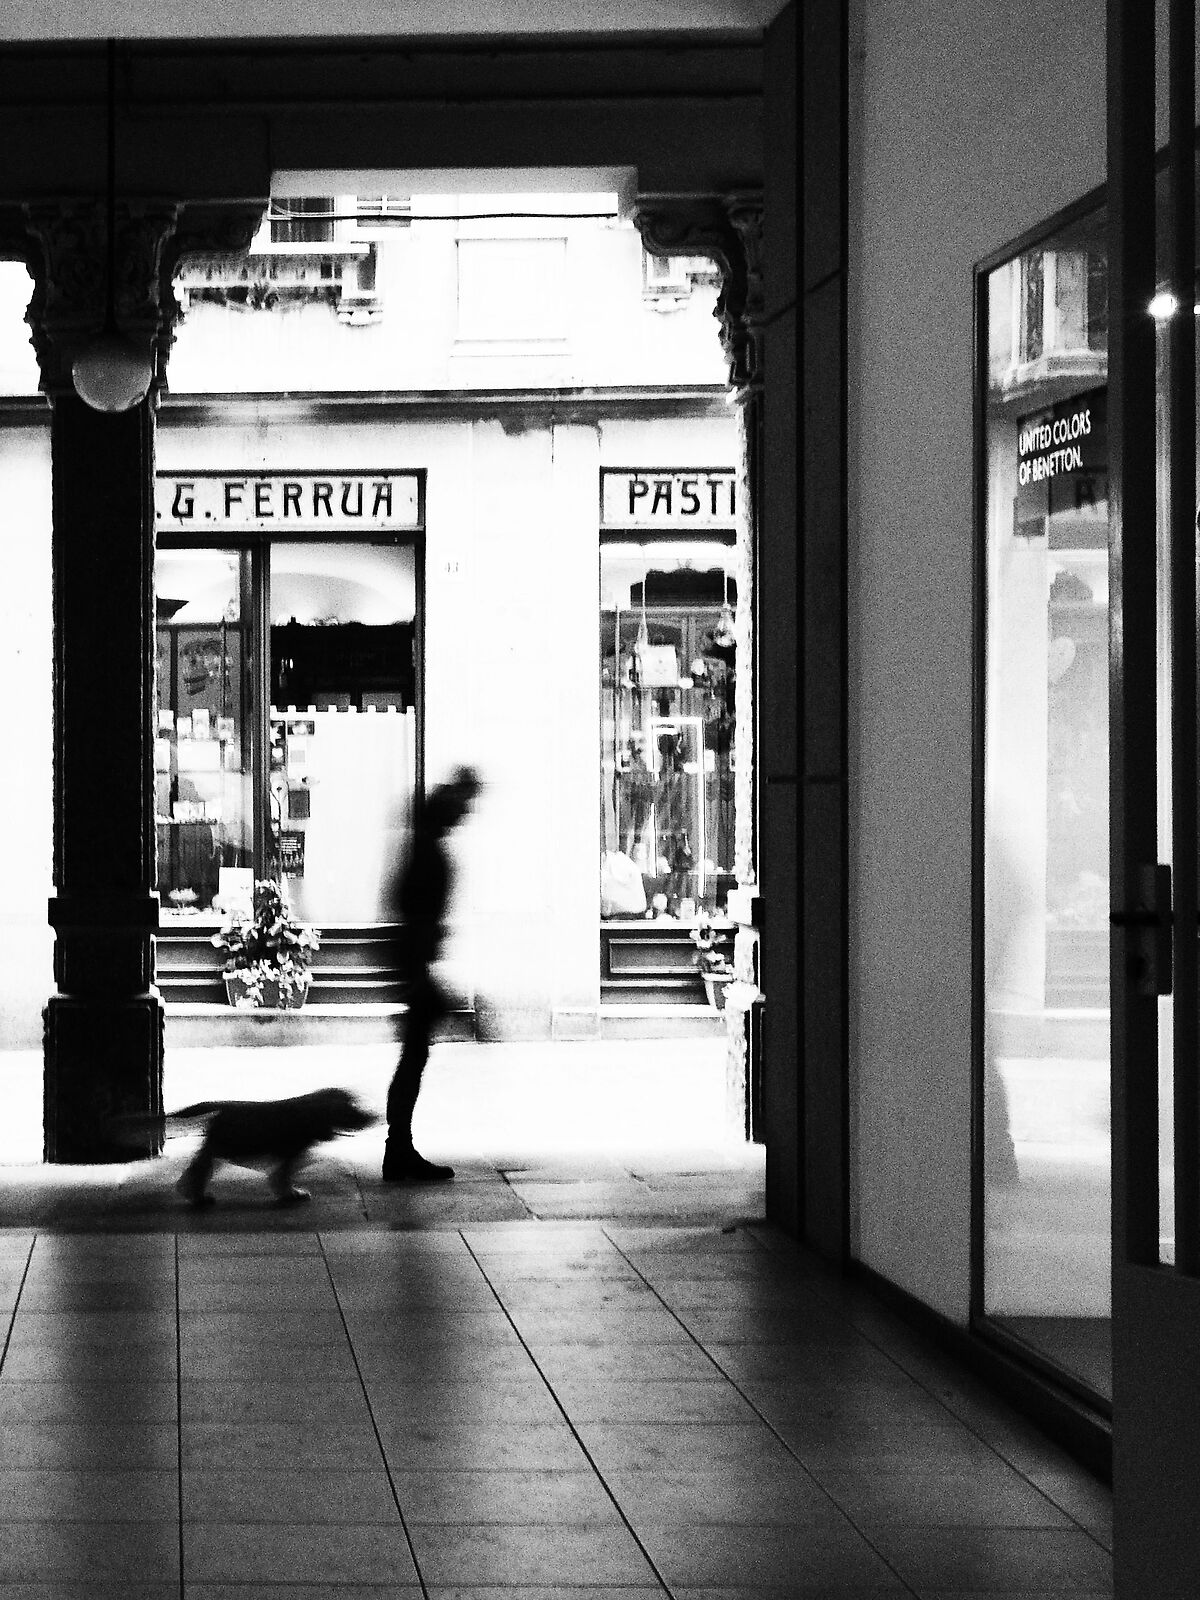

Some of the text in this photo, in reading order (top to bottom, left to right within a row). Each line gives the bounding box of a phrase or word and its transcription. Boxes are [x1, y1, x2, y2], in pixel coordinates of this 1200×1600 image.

[1019, 409, 1091, 456] UNITED COLORS
[1019, 459, 1031, 486] OF
